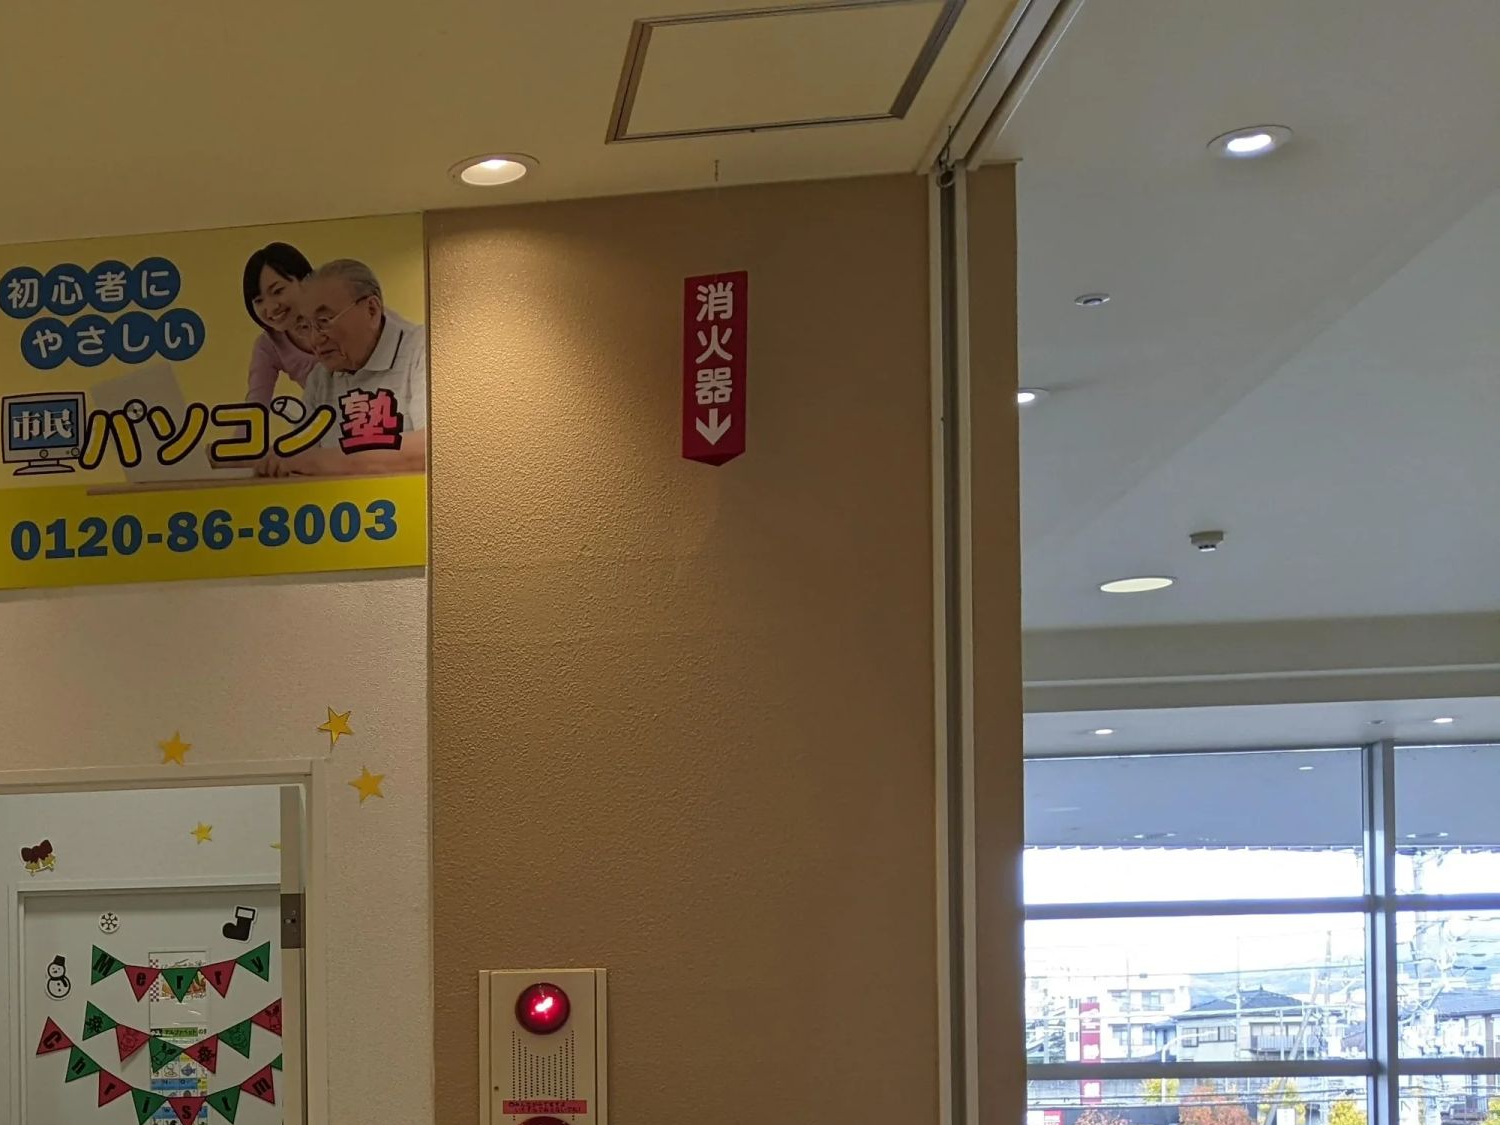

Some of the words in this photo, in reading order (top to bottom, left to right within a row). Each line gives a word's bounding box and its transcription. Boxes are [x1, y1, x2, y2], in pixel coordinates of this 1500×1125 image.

[7, 269, 171, 309] 初心者に
[31, 322, 196, 359] やさしい
[696, 282, 734, 405] 消火器
[10, 499, 398, 561] 0120-86-8003
